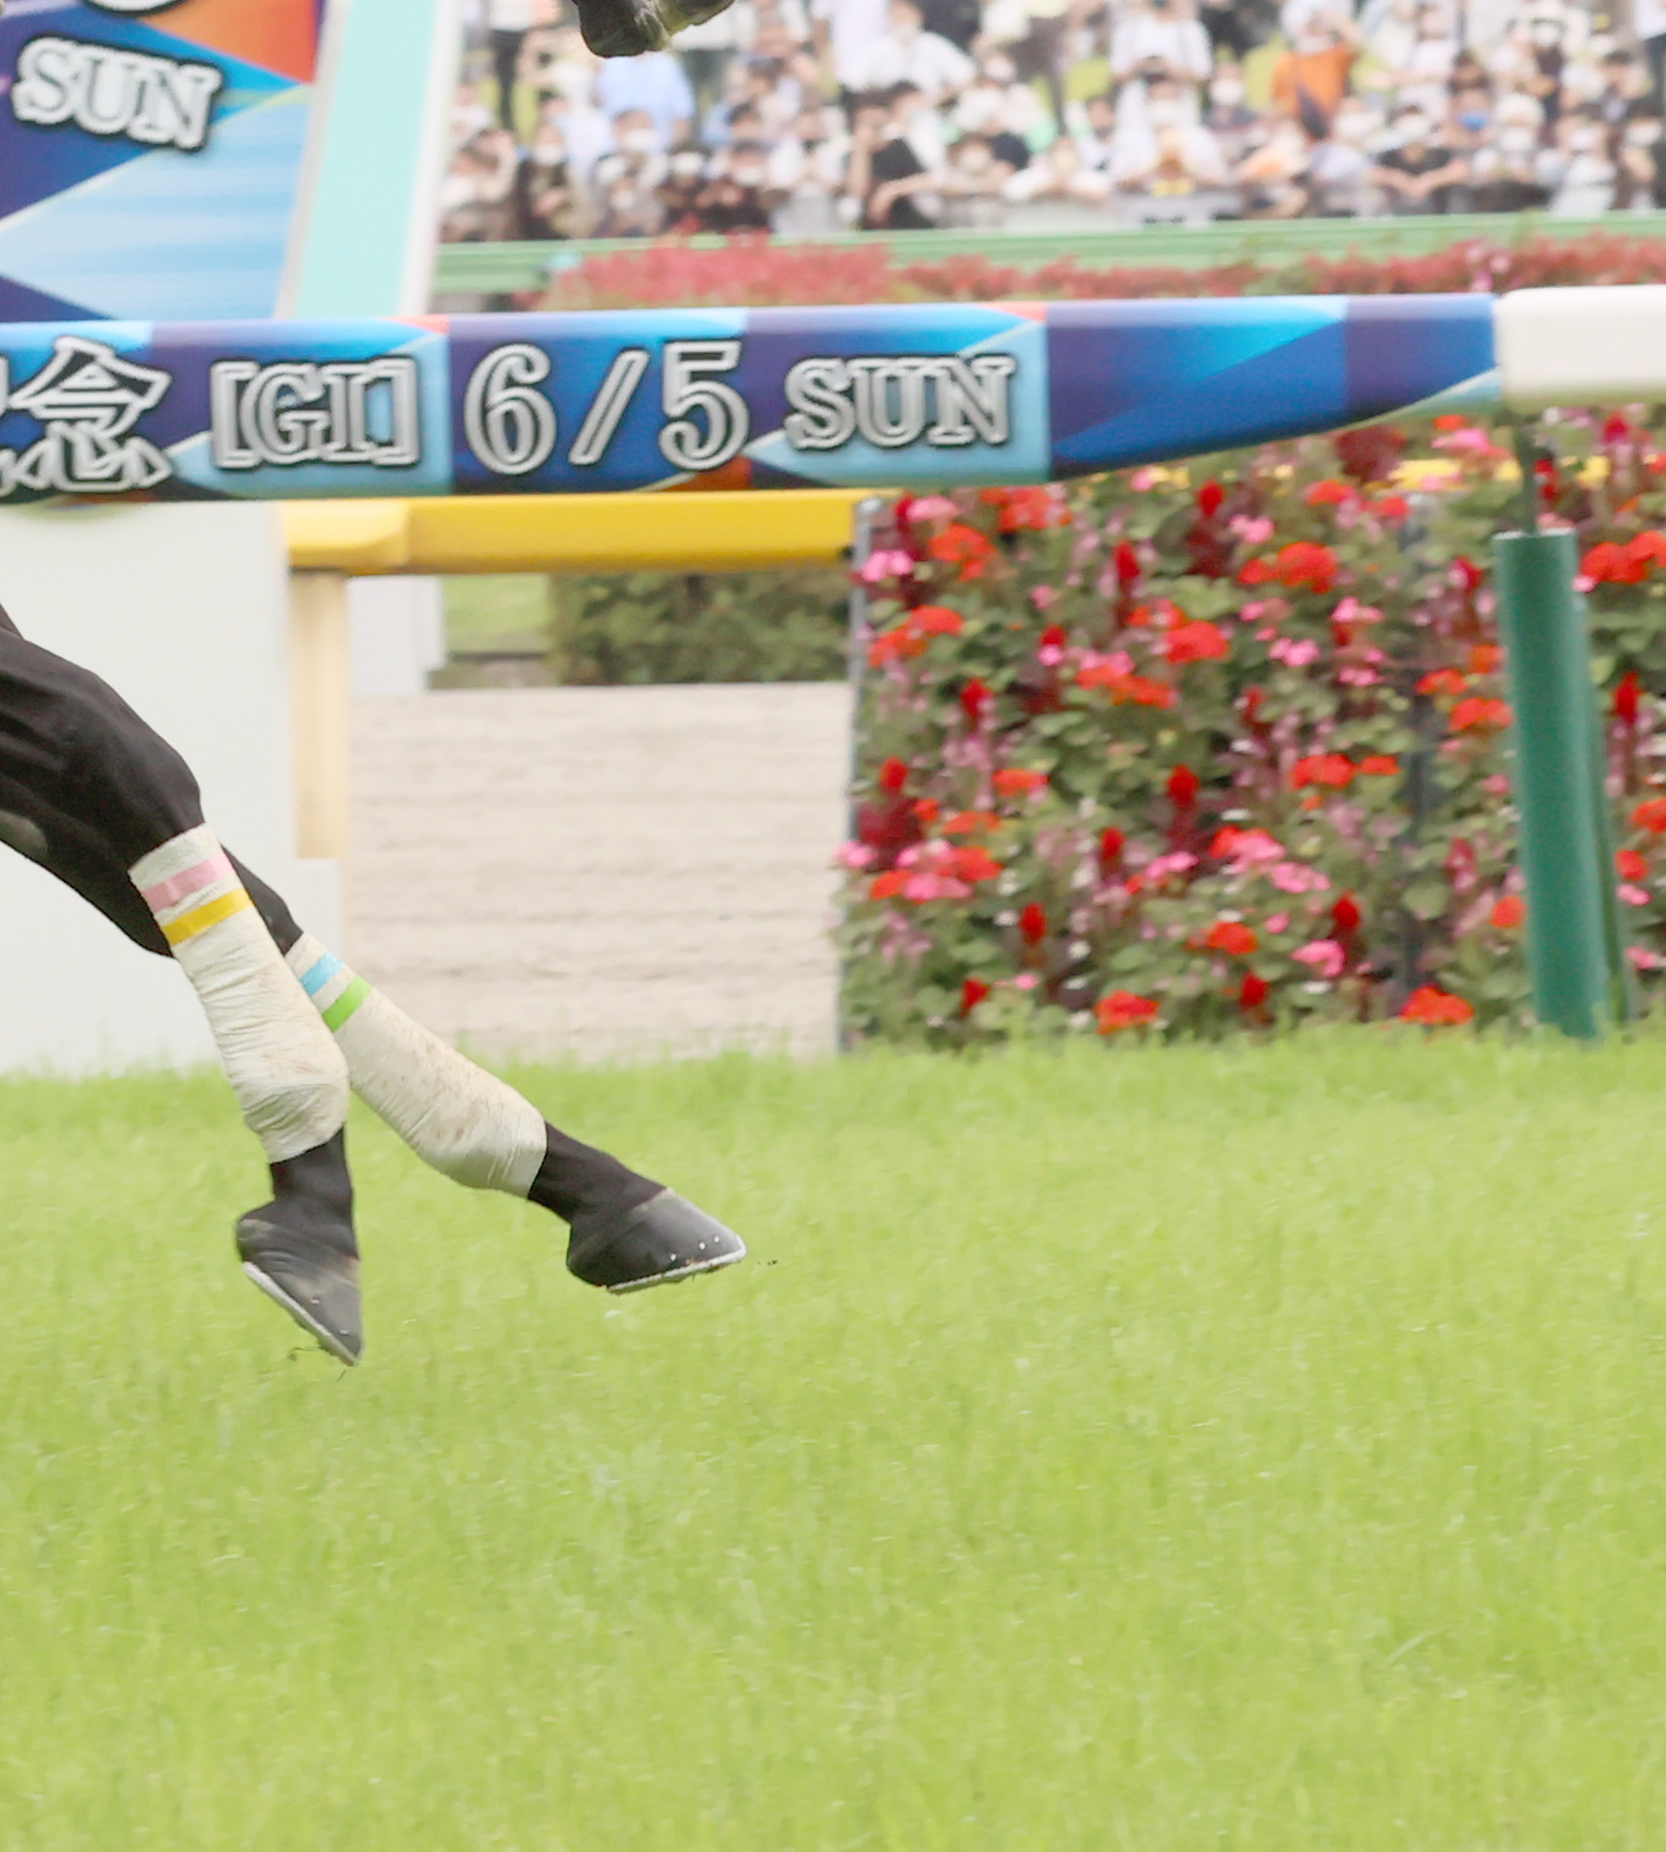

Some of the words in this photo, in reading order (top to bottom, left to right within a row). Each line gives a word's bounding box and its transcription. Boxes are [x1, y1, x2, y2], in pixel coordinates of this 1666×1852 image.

[9, 37, 224, 151] SUN
[466, 336, 752, 474] 6/5
[781, 353, 1012, 453] SUN
